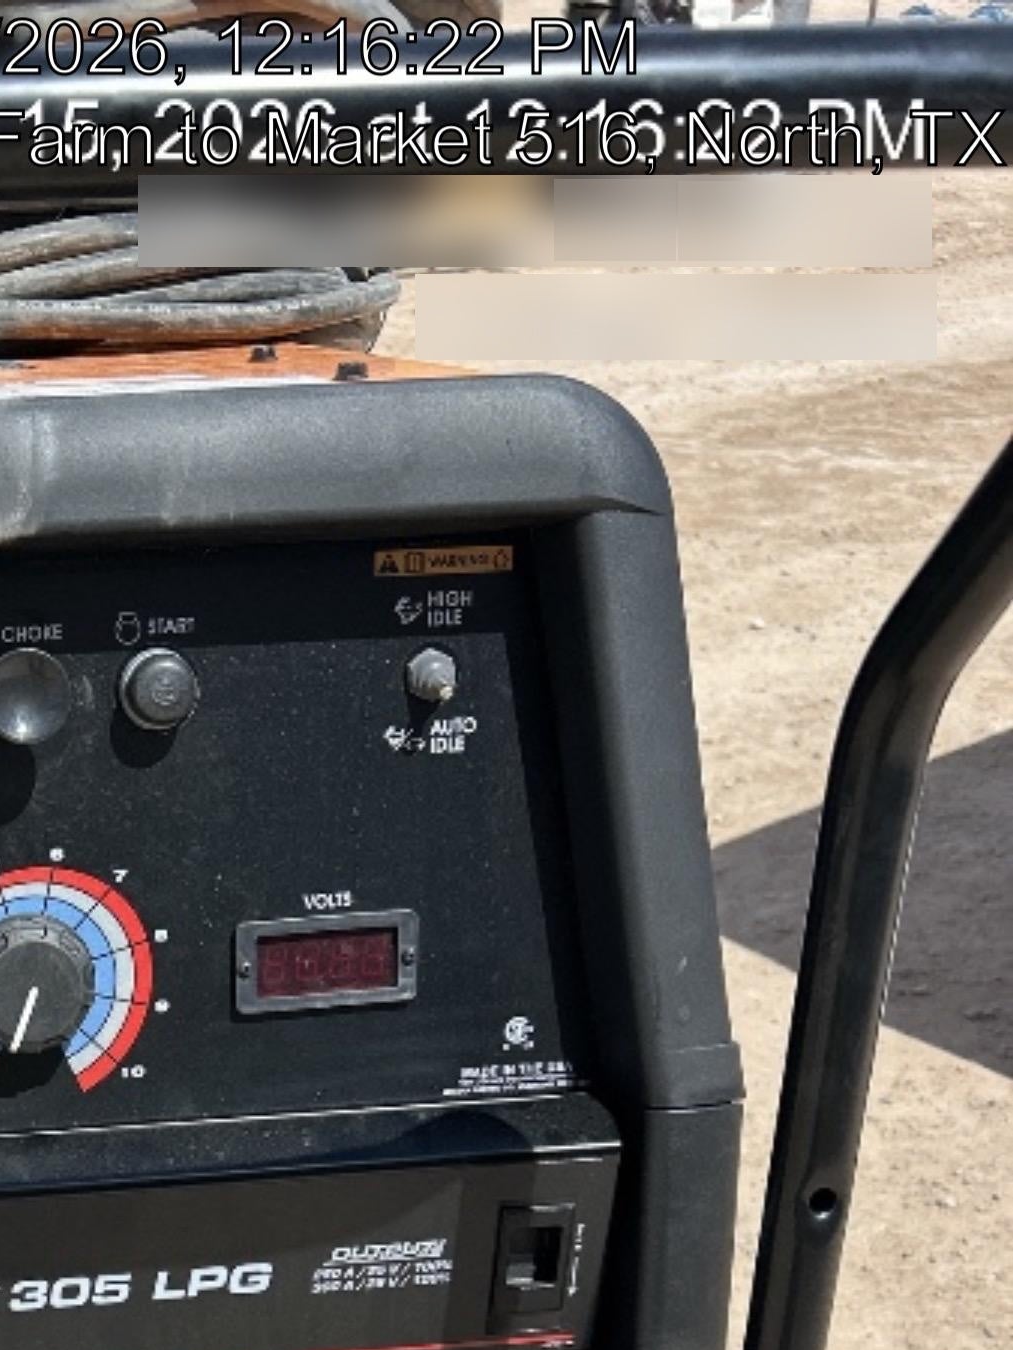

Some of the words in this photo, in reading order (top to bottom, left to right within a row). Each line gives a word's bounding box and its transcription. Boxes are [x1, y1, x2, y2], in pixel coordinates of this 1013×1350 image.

[427, 590, 473, 607] HIGH
[147, 616, 195, 634] START
[427, 608, 462, 627] IDLE
[0, 623, 63, 643] CHOKE
[429, 716, 477, 735] AUTO
[429, 735, 466, 754] IDLE
[112, 868, 129, 882] 7
[301, 890, 353, 910] VOLTS
[121, 1065, 146, 1078] 10
[7, 1270, 133, 1313] 305
[151, 1261, 275, 1302] LPG
